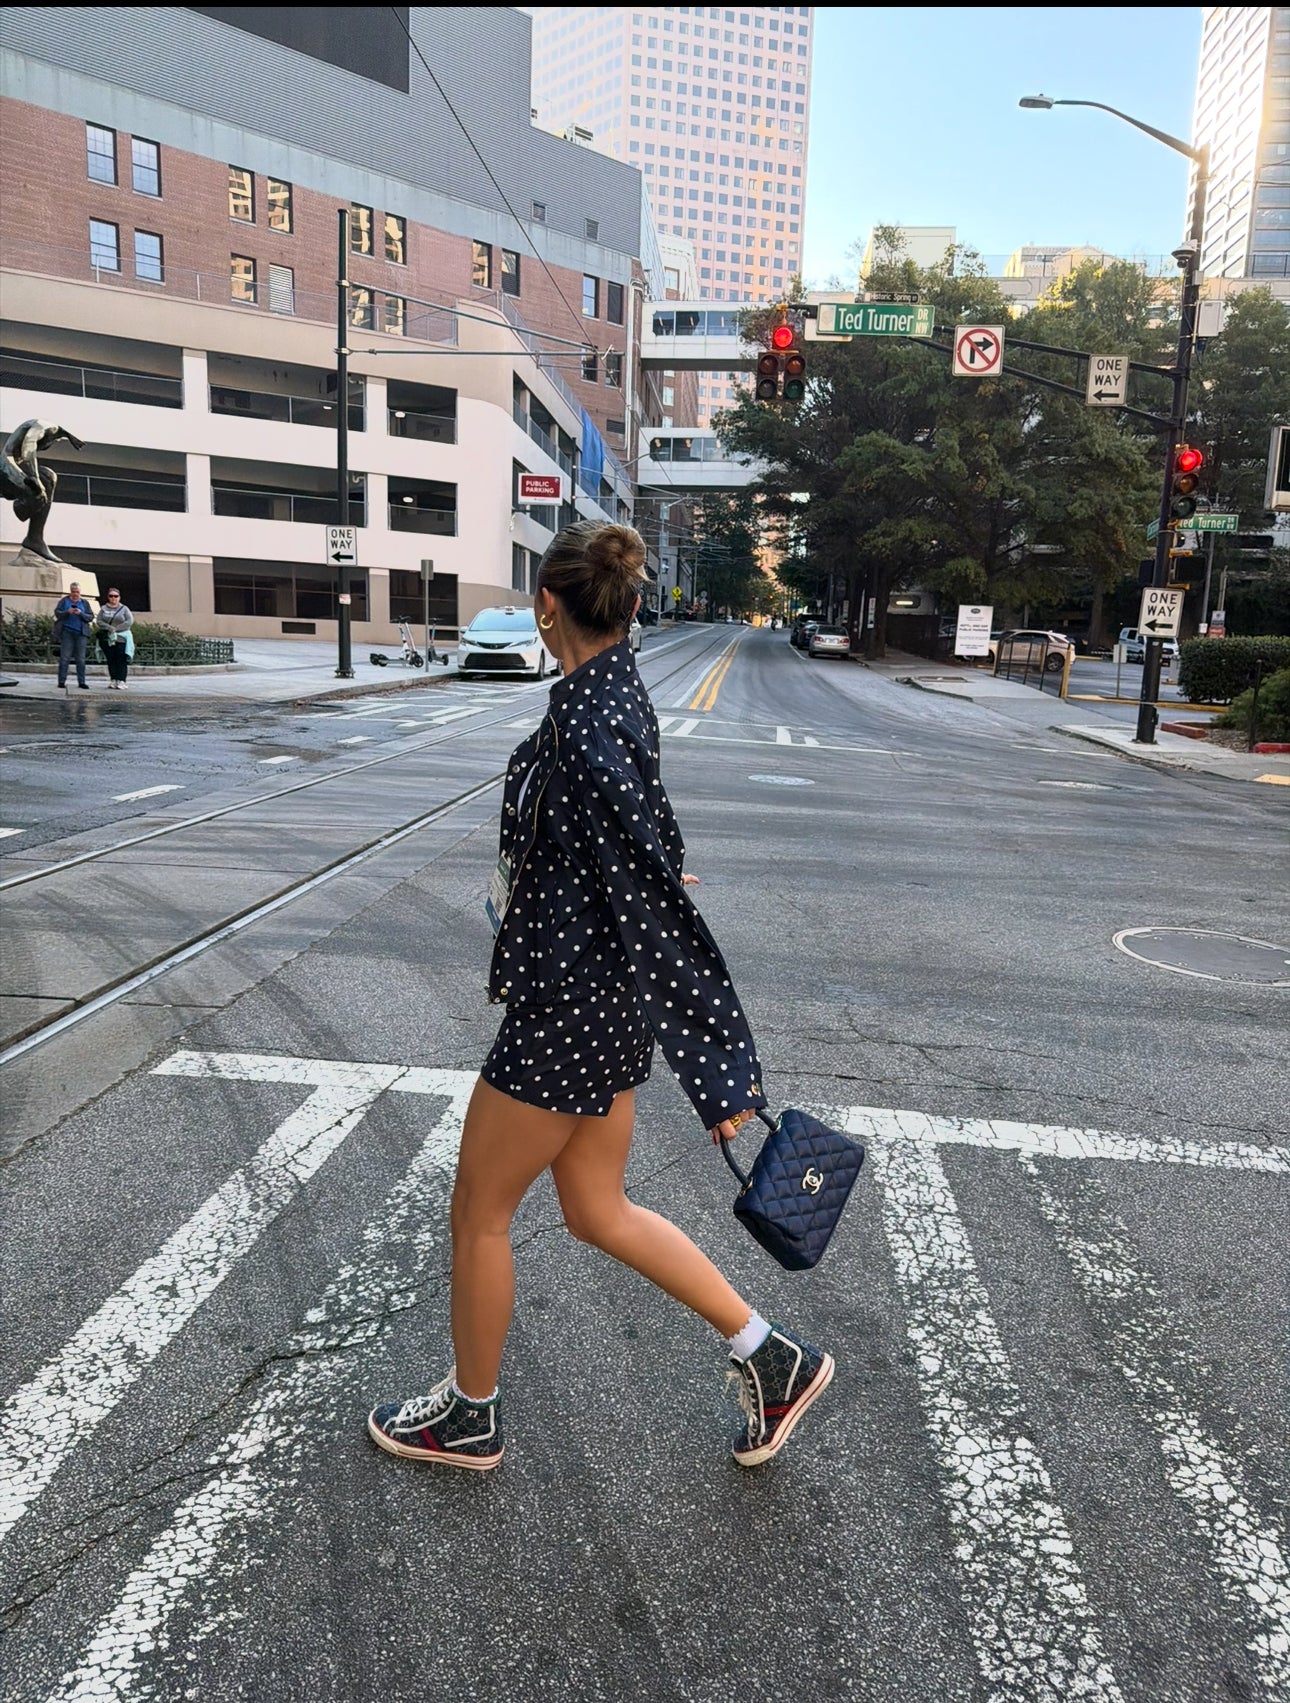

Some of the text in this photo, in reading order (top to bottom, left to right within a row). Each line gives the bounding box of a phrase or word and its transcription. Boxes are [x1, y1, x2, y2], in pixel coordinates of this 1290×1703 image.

[838, 308, 915, 332] Ted Turner
[917, 308, 929, 321] DR
[915, 321, 929, 334] NW
[1096, 359, 1122, 371] ONE
[1094, 374, 1121, 386] WAY
[525, 486, 555, 494] PARKING
[1198, 517, 1226, 529] Turner
[331, 528, 353, 539] ONE
[330, 539, 353, 549] WAY
[1149, 592, 1178, 605] ONE
[1147, 605, 1175, 617] WAY
